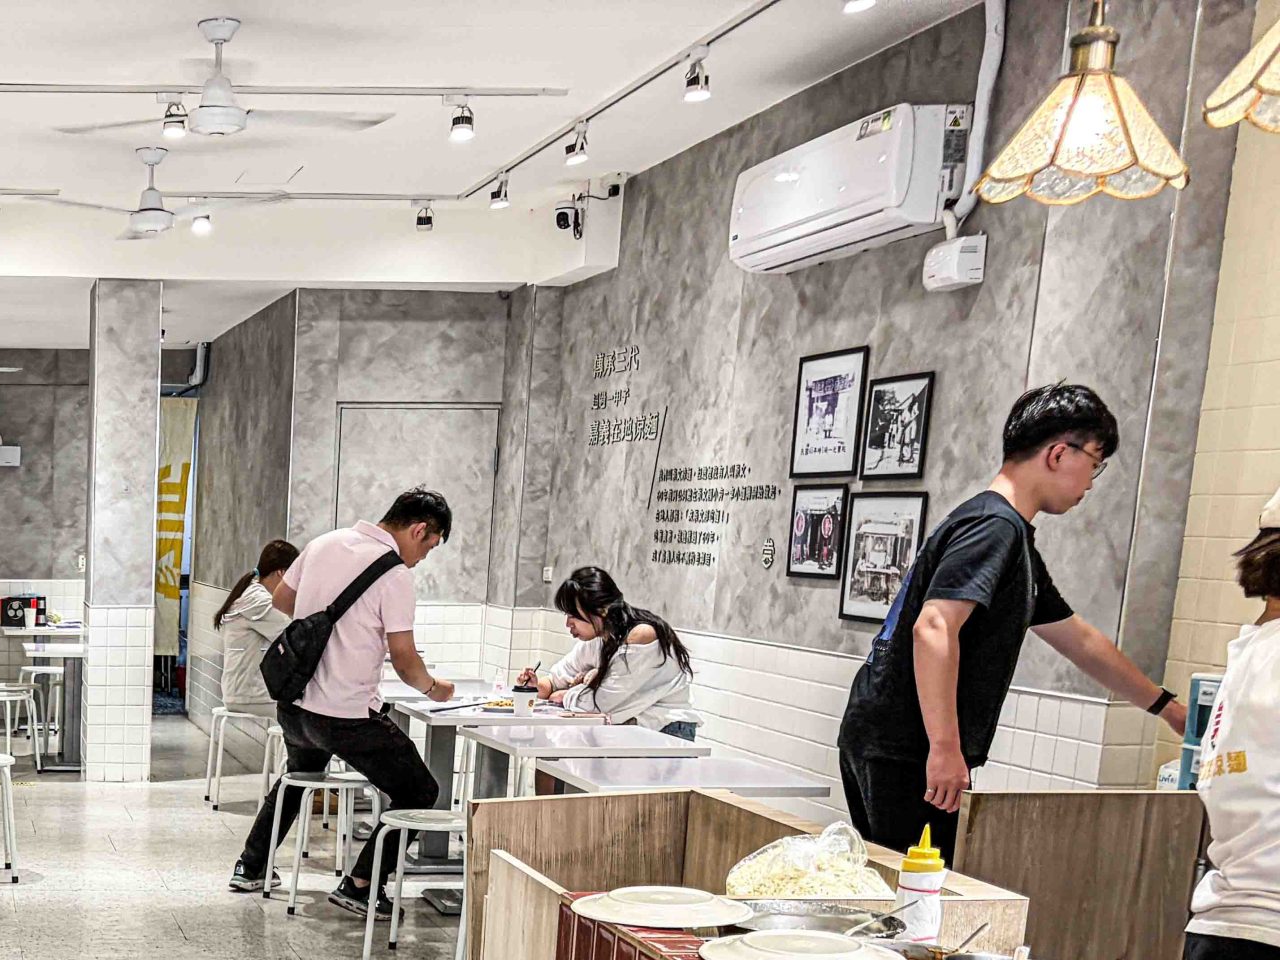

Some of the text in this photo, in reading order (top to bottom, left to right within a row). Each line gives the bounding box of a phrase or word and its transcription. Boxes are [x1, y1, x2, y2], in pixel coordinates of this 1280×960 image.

[593, 344, 640, 379] 傳承三代
[588, 412, 660, 446] 嘉義在地涼麵
